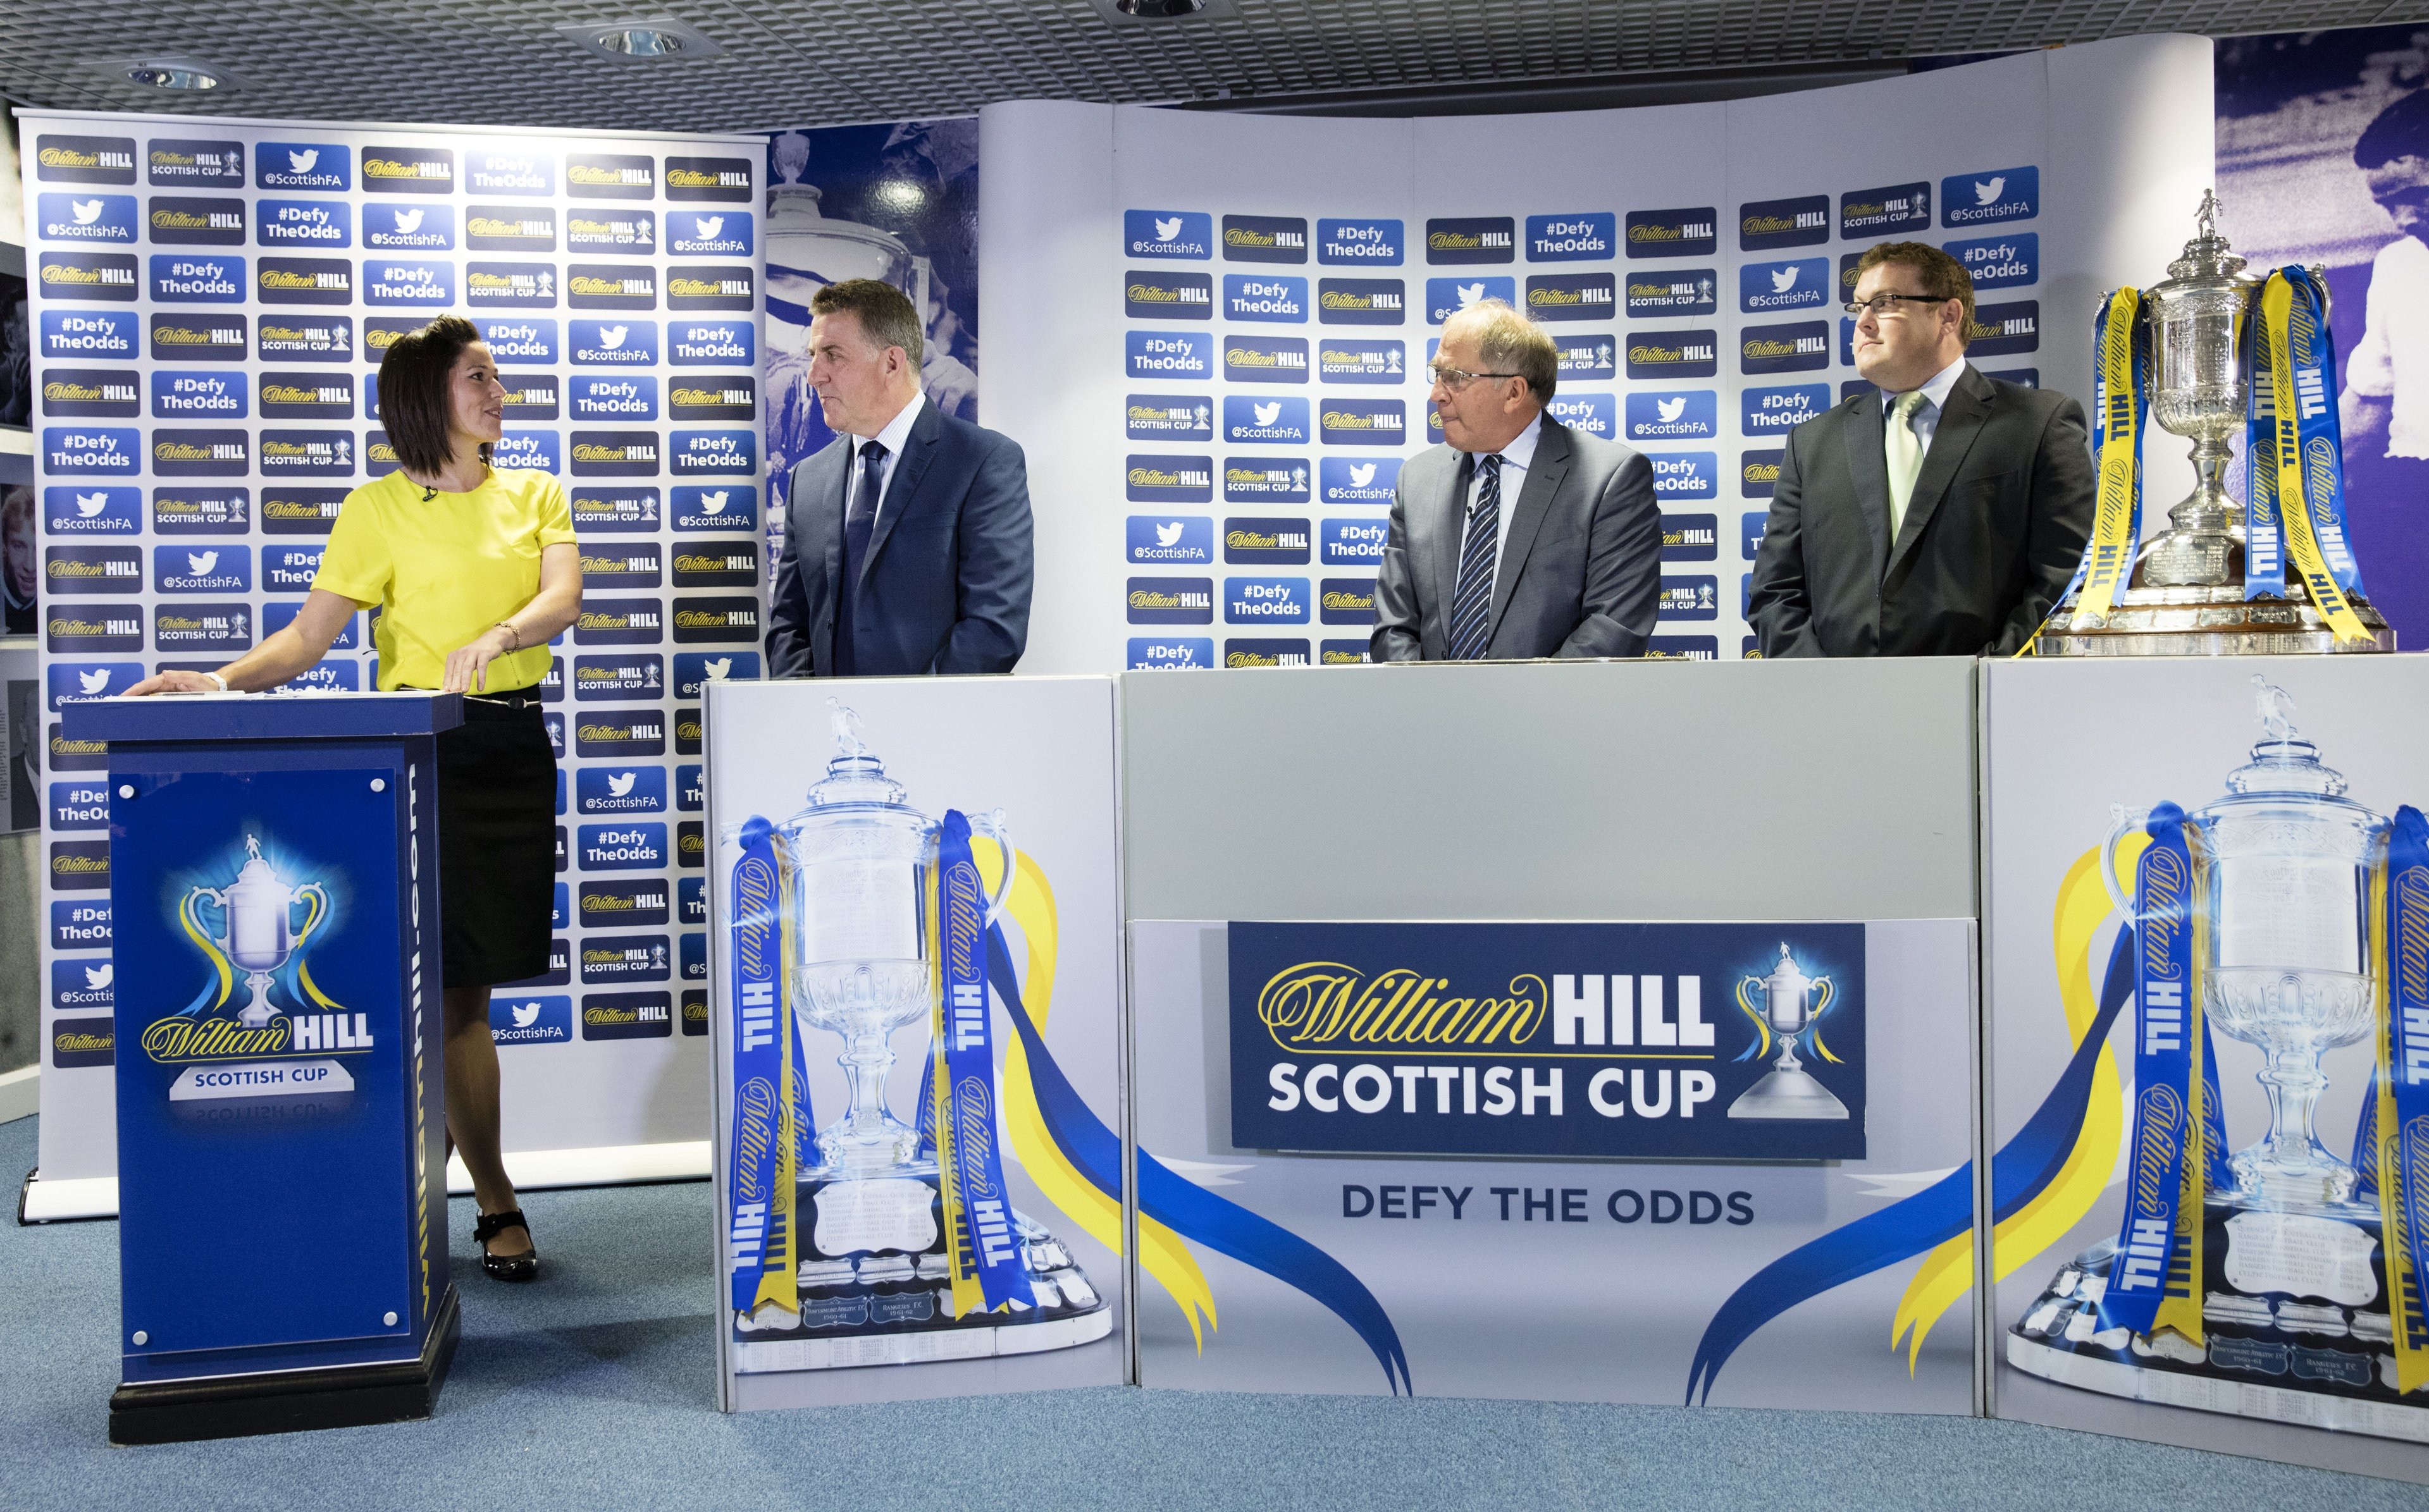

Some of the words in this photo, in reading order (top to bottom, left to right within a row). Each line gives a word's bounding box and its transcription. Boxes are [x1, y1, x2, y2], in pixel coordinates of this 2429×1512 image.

[39, 147, 99, 168] William
[99, 152, 133, 168] HILL
[151, 152, 195, 165] William
[196, 154, 222, 166] HILL
[152, 165, 199, 175] SCOTTISH
[201, 167, 222, 176] CUP
[364, 158, 419, 178] William
[420, 162, 451, 177] HILL
[265, 173, 342, 187] @ScottishFA
[667, 169, 720, 188] William
[720, 172, 749, 187] HILL
[278, 207, 330, 225] #Defy
[1844, 204, 1883, 217] William
[1885, 198, 1909, 212] HILL
[1950, 202, 2029, 221] @ScottishFA
[1844, 214, 1888, 228] SCOTTISH
[1889, 212, 1908, 222] CUP
[266, 223, 342, 239] TheOdds
[371, 233, 447, 246] @ScottishFA
[1225, 228, 1276, 249] William
[1276, 232, 1304, 247] HILL
[1337, 226, 1383, 243] #Defy
[1629, 225, 1683, 243] William
[1683, 223, 1713, 238] HILL
[674, 240, 745, 252] @ScottishFA
[1133, 241, 1204, 254] @ScottishFA
[1326, 242, 1394, 257] TheOdds
[1964, 244, 2017, 262] #Defy
[172, 262, 224, 280] #Defy
[259, 270, 317, 290] William
[317, 273, 349, 289] HILL
[159, 279, 236, 294] TheOdds
[669, 278, 721, 297] William
[721, 280, 751, 295] HILL
[1242, 283, 1289, 300] #Defy
[1628, 284, 1671, 298] William
[1671, 283, 1695, 295] HILL
[1232, 298, 1299, 314] TheOdds
[1629, 297, 1674, 307] SCOTTISH
[1676, 296, 1695, 305] CUP
[1749, 290, 1820, 307] @ScottishFA
[61, 317, 116, 336] #Defy
[2005, 317, 2036, 335] HILL
[49, 334, 128, 350] TheOdds
[687, 327, 735, 344] #Defy
[577, 349, 650, 361] @ScottishFA
[676, 343, 746, 357] TheOdds
[1571, 348, 1595, 360] HILL
[1743, 340, 1796, 359] William
[1796, 336, 1826, 353] HILL
[2108, 306, 2130, 393] William
[1575, 360, 1595, 369] CUP
[2271, 329, 2292, 419] William
[589, 382, 638, 399] #Defy
[2297, 369, 2327, 419] HILL
[578, 398, 649, 412] TheOdds
[1762, 393, 1810, 411] #Defy
[1322, 411, 1373, 431] William
[1373, 414, 1403, 429] HILL
[2110, 394, 2129, 441] HILL
[1635, 422, 1708, 434] @ScottishFA
[689, 436, 737, 453] #Defy
[2280, 420, 2296, 468] HILL
[678, 453, 748, 467] TheOdds
[2250, 438, 2277, 526] William
[2304, 436, 2340, 527] William
[156, 500, 201, 514] William
[201, 500, 227, 512] HILL
[2099, 459, 2128, 544] William
[53, 517, 132, 529] @ScottishFA
[157, 514, 204, 523] SCOTTISH
[207, 514, 227, 523] CUP
[679, 515, 750, 527] @ScottishFA
[1340, 526, 1387, 543] #Defy
[1684, 529, 1714, 544] HILL
[1134, 547, 1205, 558] @ScottishFA
[2251, 526, 2277, 575] HILL
[2282, 486, 2318, 575] William
[2309, 573, 2344, 616] HILL
[2319, 526, 2350, 574] HILL
[674, 555, 727, 572] William
[727, 556, 755, 570] HILL
[2091, 545, 2118, 588] HILL
[164, 576, 242, 588] @ScottishFA
[1129, 590, 1181, 610] William
[1181, 593, 1210, 607] HILL
[1244, 584, 1290, 601] #Defy
[1323, 591, 1375, 610] William
[1672, 588, 1696, 599] HILL
[1232, 601, 1301, 615] TheOdds
[1677, 601, 1696, 610] CUP
[48, 619, 106, 637] William
[106, 620, 140, 635] HILL
[1147, 645, 1194, 663] #Defy
[577, 667, 619, 681] William
[619, 667, 643, 679] HILL
[578, 680, 622, 690] SCOTTISH
[624, 680, 643, 689] CUP
[586, 796, 658, 809] @ScottishFA
[598, 830, 646, 847] #Defy
[586, 846, 658, 861] TheOdds
[53, 855, 111, 875] William
[736, 857, 776, 981] William
[944, 861, 984, 983] William
[2140, 846, 2187, 980] William
[584, 1007, 638, 1025] William
[638, 1006, 669, 1021] HILL
[742, 981, 773, 1052] HILL
[1258, 961, 1547, 1055] William
[1553, 974, 1715, 1046] HILL
[953, 984, 984, 1052] HILL
[2145, 981, 2182, 1055] HILL
[55, 1033, 114, 1052] William
[142, 1016, 292, 1063] William
[294, 1013, 374, 1050] HILL
[491, 1027, 564, 1040] @ScottishFA
[195, 1069, 284, 1087] SCOTTISH
[292, 1067, 328, 1081] CUP
[1268, 1062, 1563, 1116] SCOTTISH
[1588, 1067, 1716, 1119] CUP
[737, 1076, 777, 1203] William
[956, 1076, 999, 1200] William
[2137, 1083, 2184, 1220] William
[1342, 1184, 1474, 1221] DEFY
[1490, 1187, 1588, 1222] THE
[1607, 1189, 1755, 1226] ODDS
[731, 1203, 765, 1274] HILL
[973, 1200, 1015, 1268] HILL
[2120, 1218, 2168, 1291] HILL
